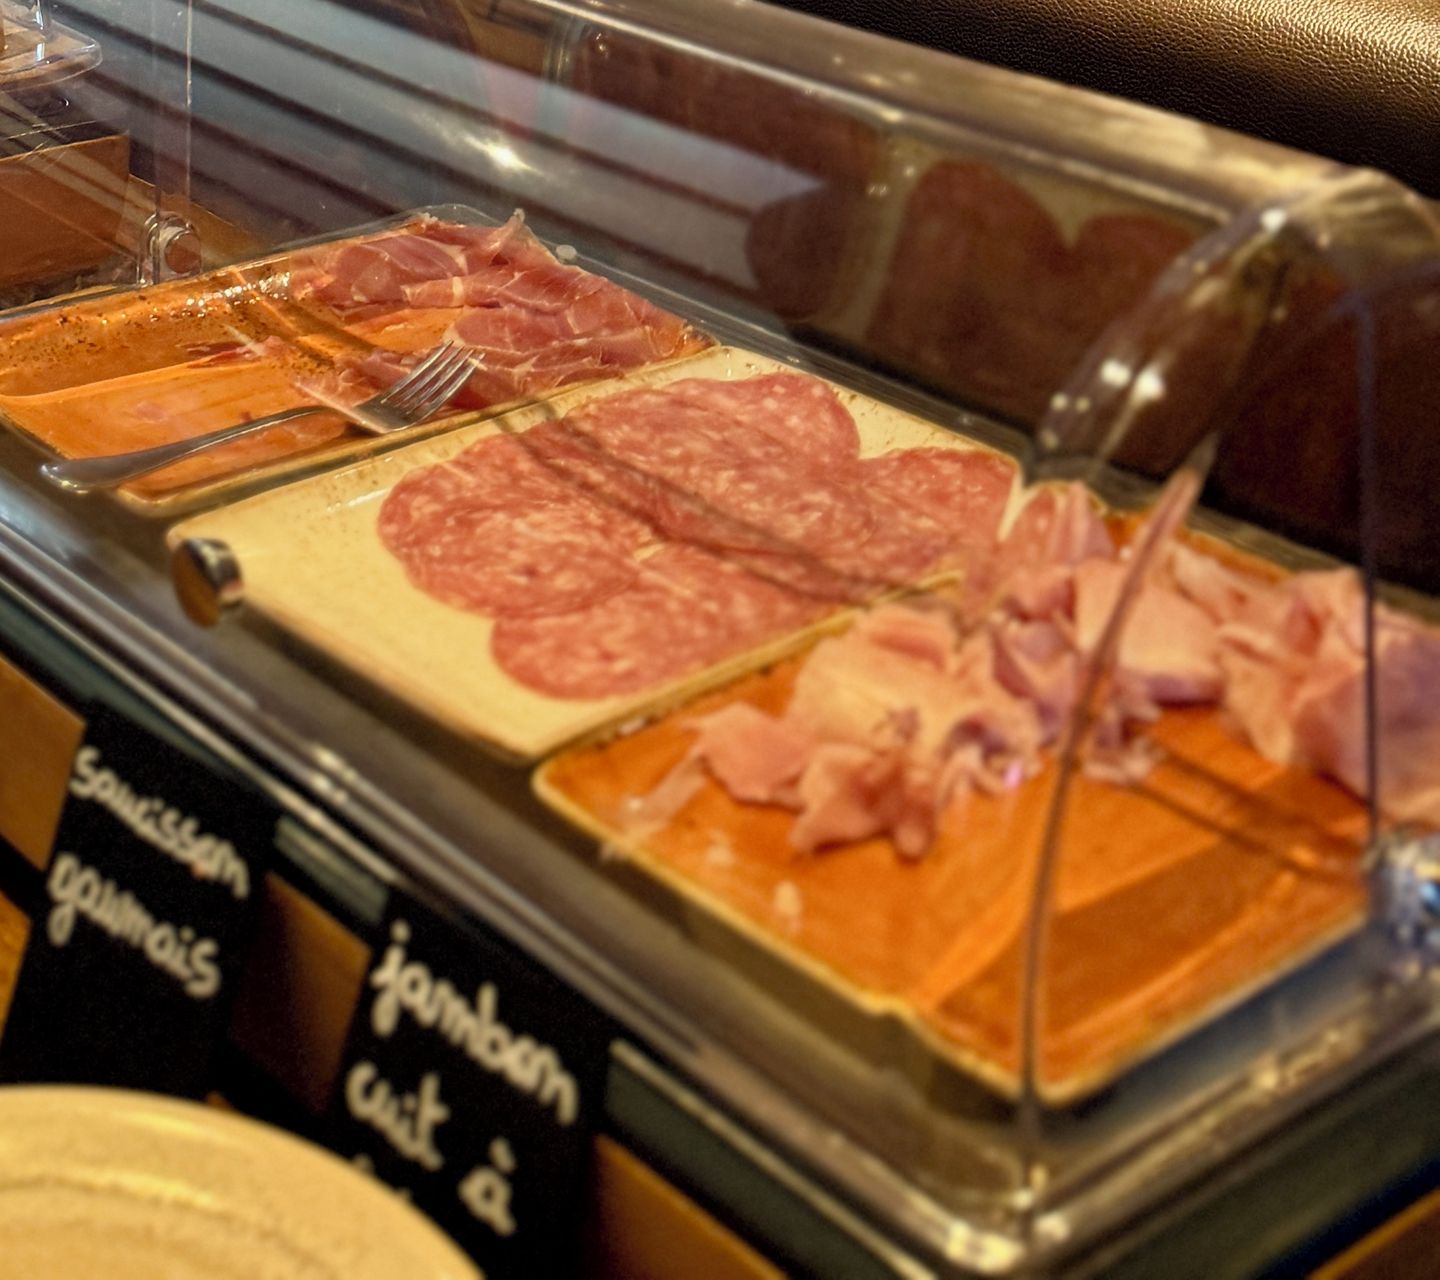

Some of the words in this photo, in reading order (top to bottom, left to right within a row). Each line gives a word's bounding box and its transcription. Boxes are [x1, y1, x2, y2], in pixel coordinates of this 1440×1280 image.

[371, 920, 578, 1125] jambon
[347, 1061, 448, 1171] cuit
[459, 1138, 515, 1238] à
